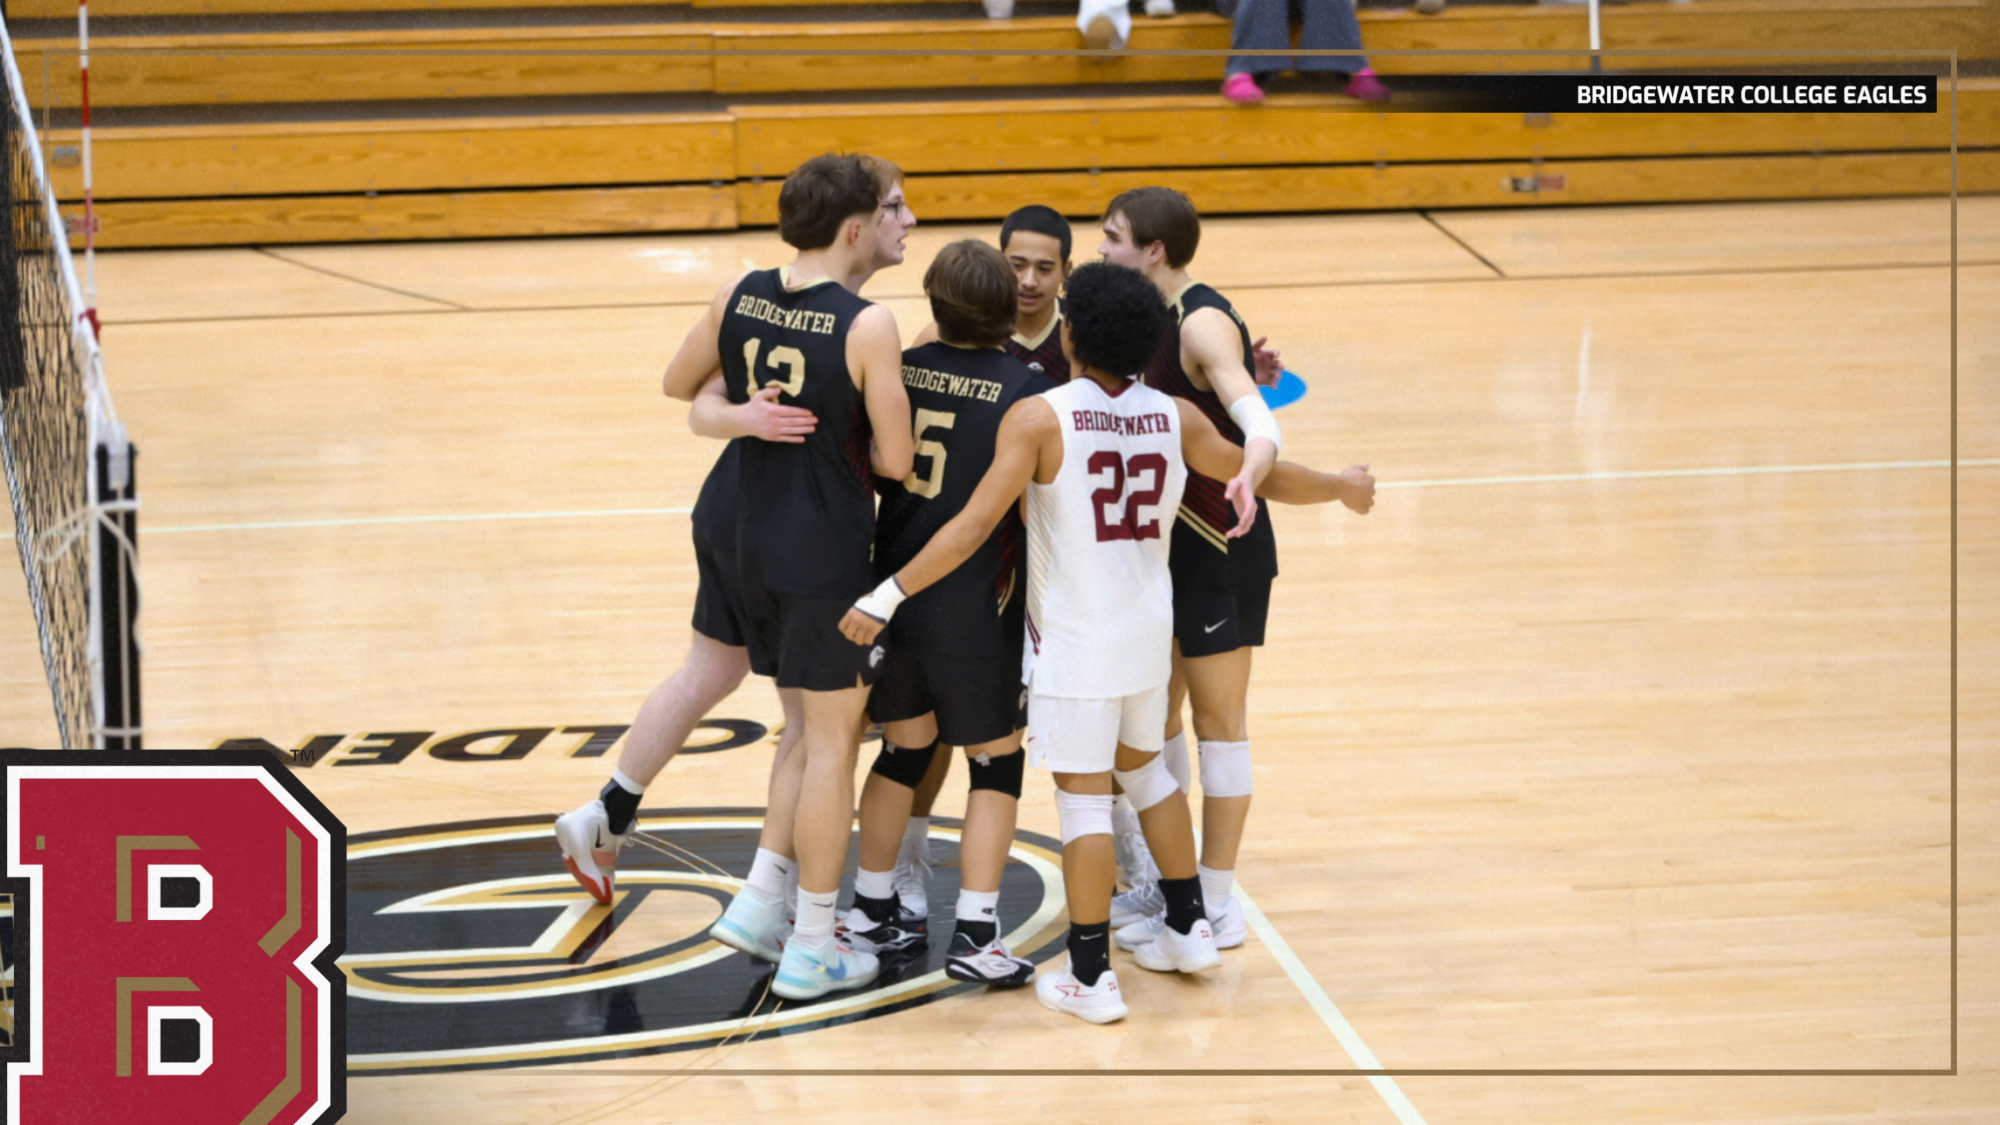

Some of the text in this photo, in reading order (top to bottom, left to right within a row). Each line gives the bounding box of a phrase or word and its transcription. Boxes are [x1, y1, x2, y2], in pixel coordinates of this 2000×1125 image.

[735, 294, 836, 334] BRIDGEWATER
[743, 337, 806, 405] 12
[1072, 410, 1171, 436] BRIDGEWATER
[903, 407, 956, 500] 5
[1087, 450, 1168, 543] 22
[203, 717, 885, 769] OLDEN
